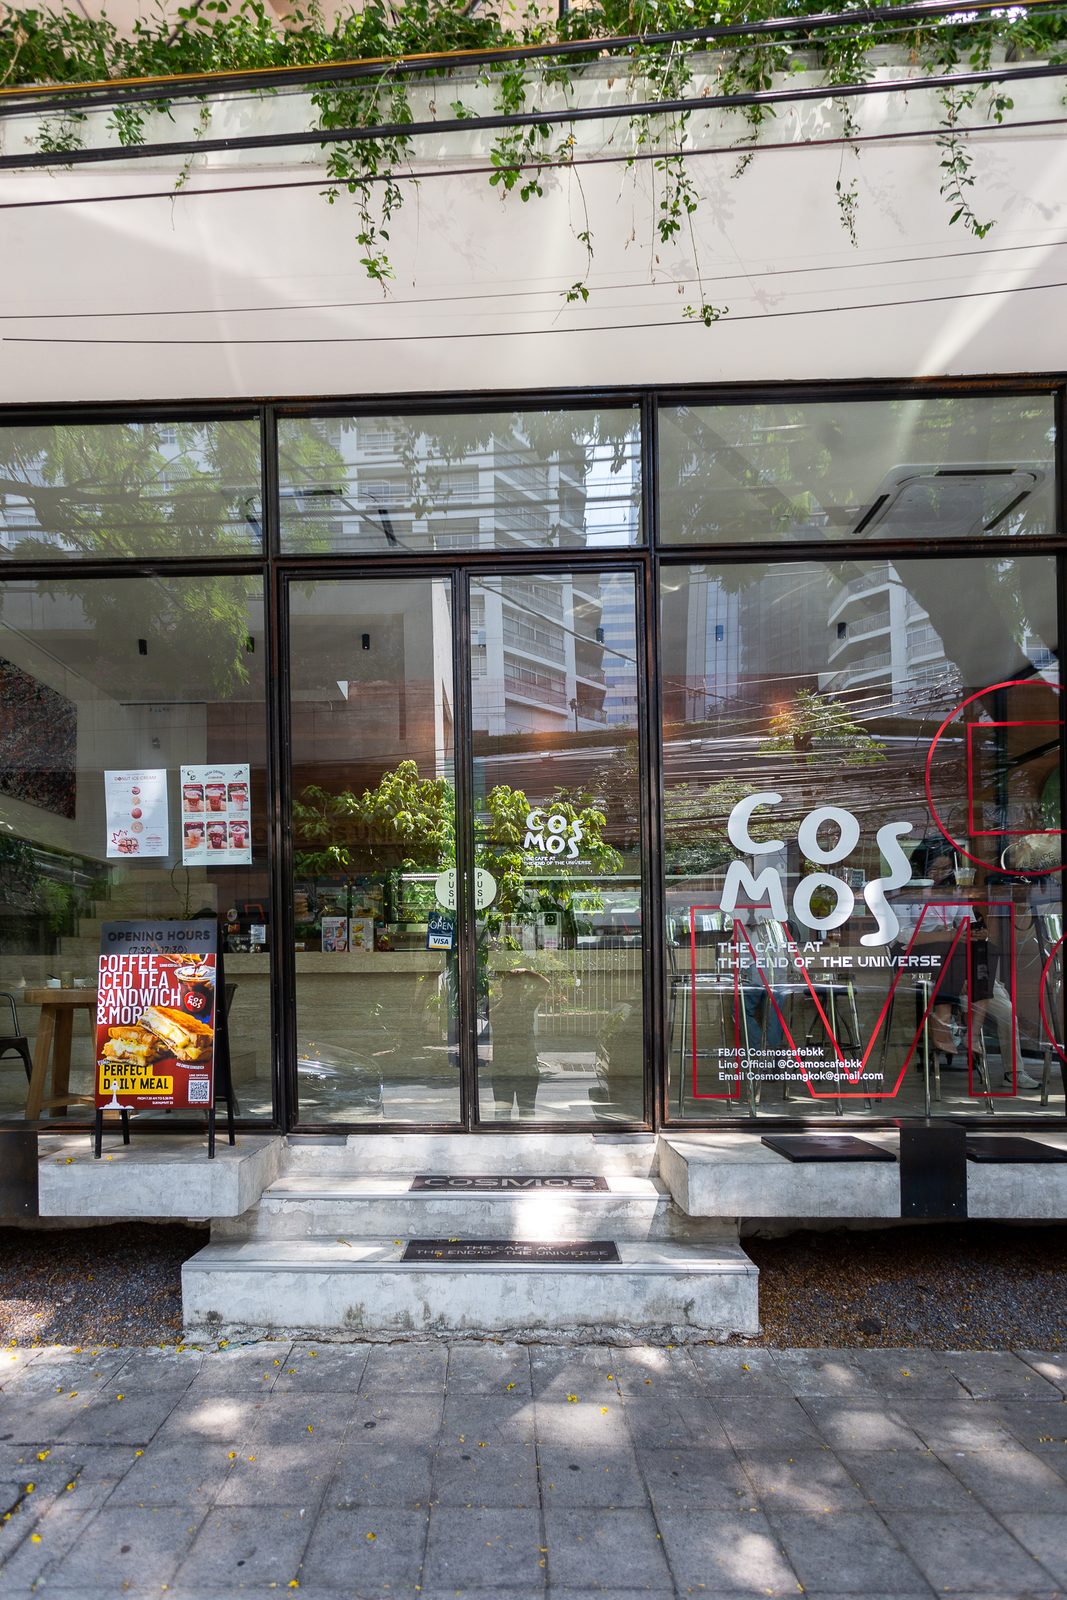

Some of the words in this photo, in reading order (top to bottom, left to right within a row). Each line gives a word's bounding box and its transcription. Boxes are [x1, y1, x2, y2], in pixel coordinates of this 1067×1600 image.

[430, 921, 454, 931] OPEN
[108, 931, 163, 942] OPENING
[167, 930, 210, 941] HOURS
[718, 943, 750, 953] THE
[755, 942, 798, 953] CAFE
[803, 942, 823, 953] AT
[98, 954, 159, 973] COFFEE
[718, 957, 750, 969] THE
[756, 957, 789, 968] END
[794, 957, 815, 968] OF
[820, 956, 853, 968] THE
[858, 955, 942, 968] UNIVERSE
[98, 971, 133, 990] ICED
[139, 971, 169, 989] TEA
[97, 988, 181, 1007] SANDWICH
[718, 1048, 746, 1058] FB/IG
[749, 1048, 824, 1057] Cosmoscafebkk
[104, 1064, 148, 1076] PERFECT
[718, 1060, 739, 1069] Line
[741, 1060, 776, 1069] Official
[777, 1059, 863, 1069] @Cosmoscafebkk
[718, 1071, 745, 1081] Email
[747, 1071, 884, 1082] Cosmosbangkok@gmail.com
[103, 1078, 138, 1090] DILY
[140, 1078, 169, 1090] MEAL
[424, 1178, 597, 1188] COSMOS
